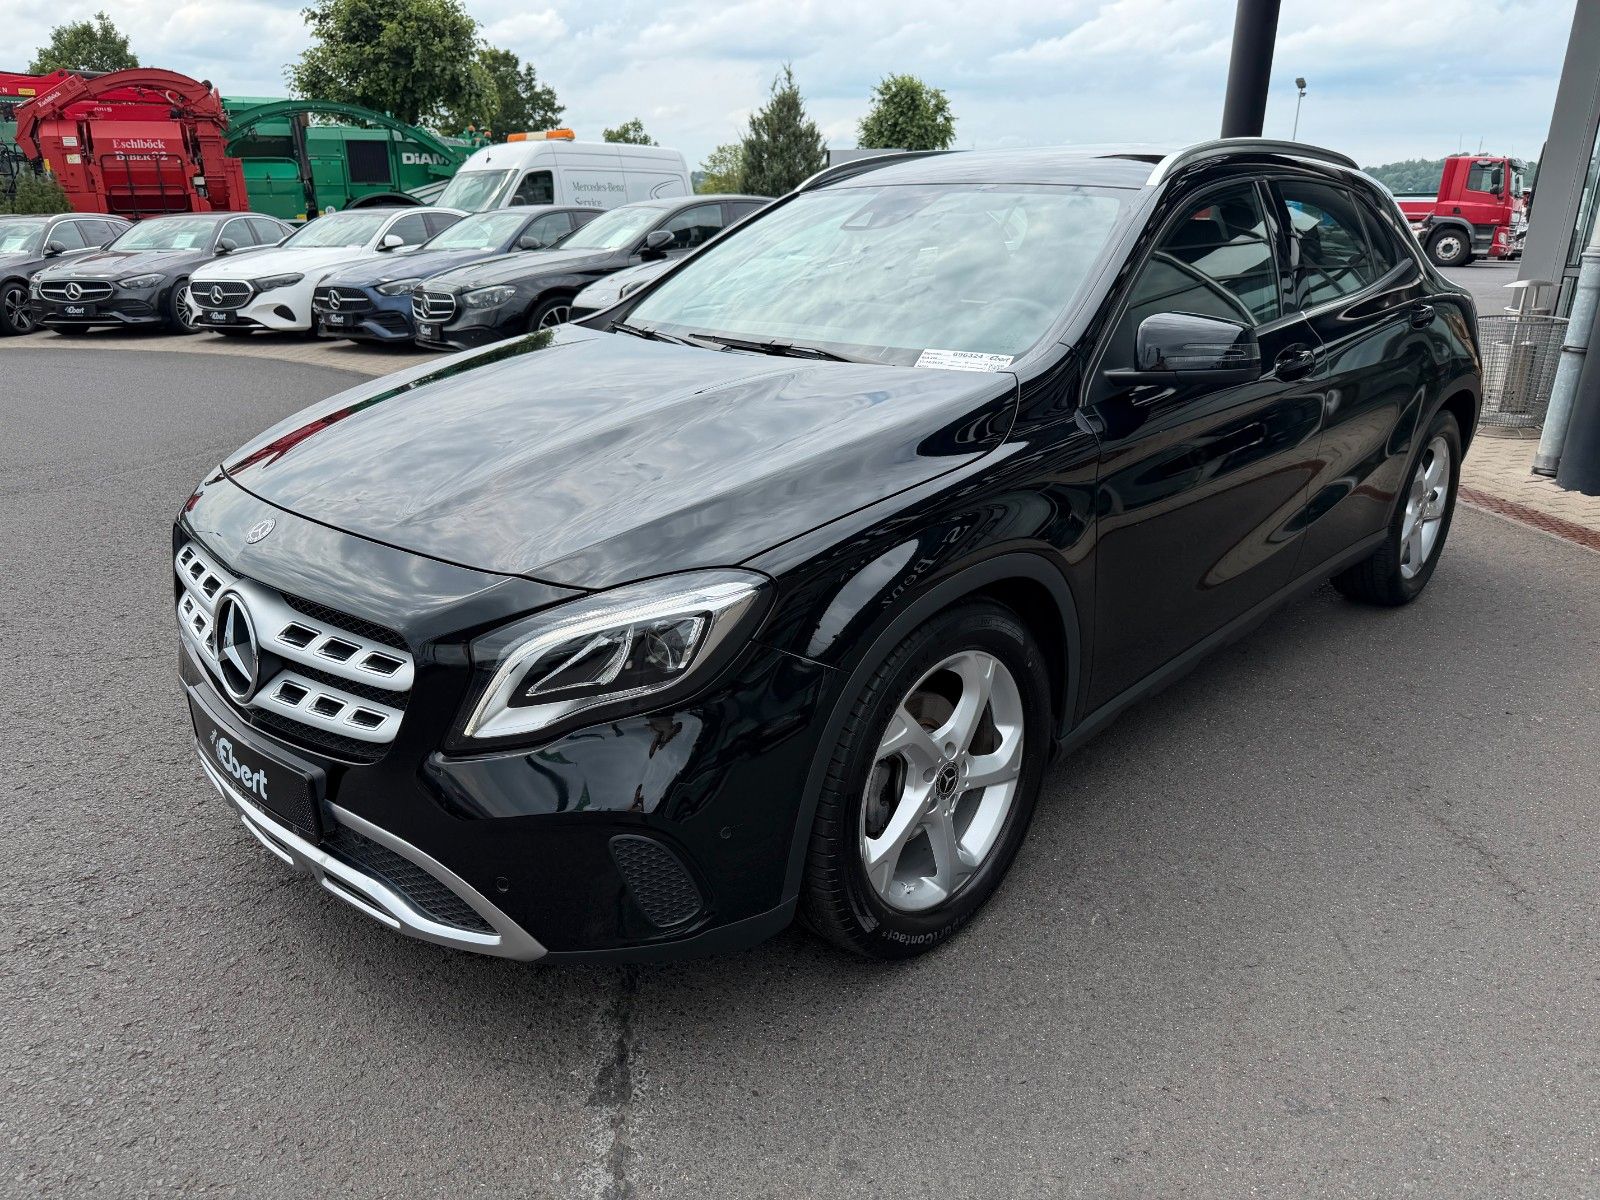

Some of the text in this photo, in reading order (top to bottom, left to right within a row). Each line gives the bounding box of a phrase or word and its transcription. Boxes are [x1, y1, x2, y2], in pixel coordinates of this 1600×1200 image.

[112, 138, 166, 149] Eschlböck
[572, 181, 625, 192] Mercedes-Benz
[575, 197, 602, 208] Service
[217, 737, 267, 800] Ebert
